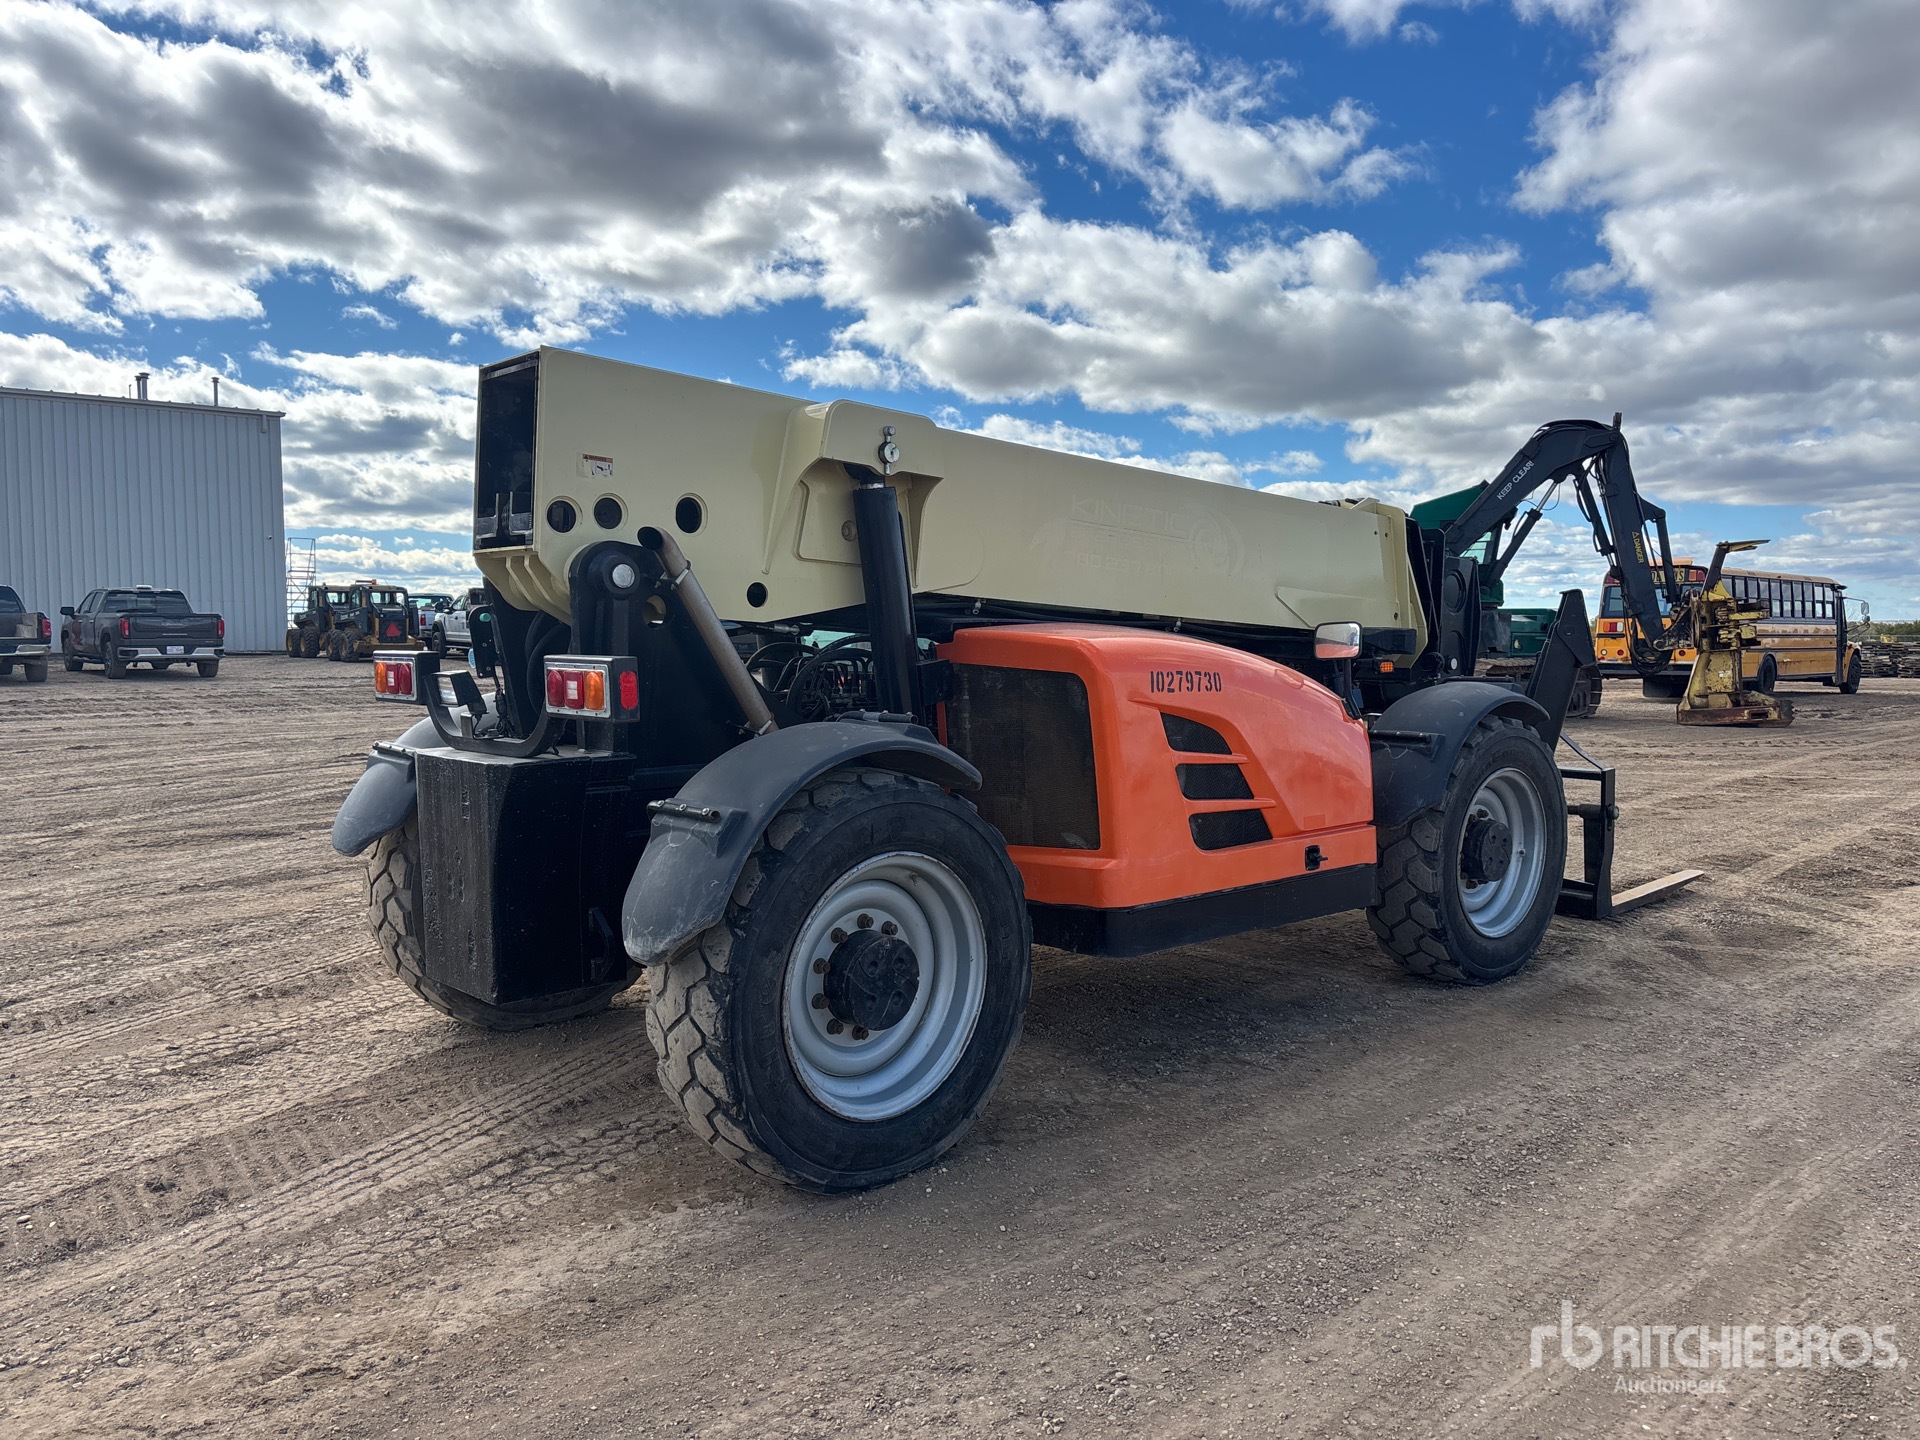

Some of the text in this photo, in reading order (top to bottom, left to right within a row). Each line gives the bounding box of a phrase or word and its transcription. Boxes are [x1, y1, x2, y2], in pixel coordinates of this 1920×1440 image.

[1496, 482, 1513, 500] KEEP
[1633, 538, 1645, 564] DANGER
[1150, 670, 1222, 693] 10279730
